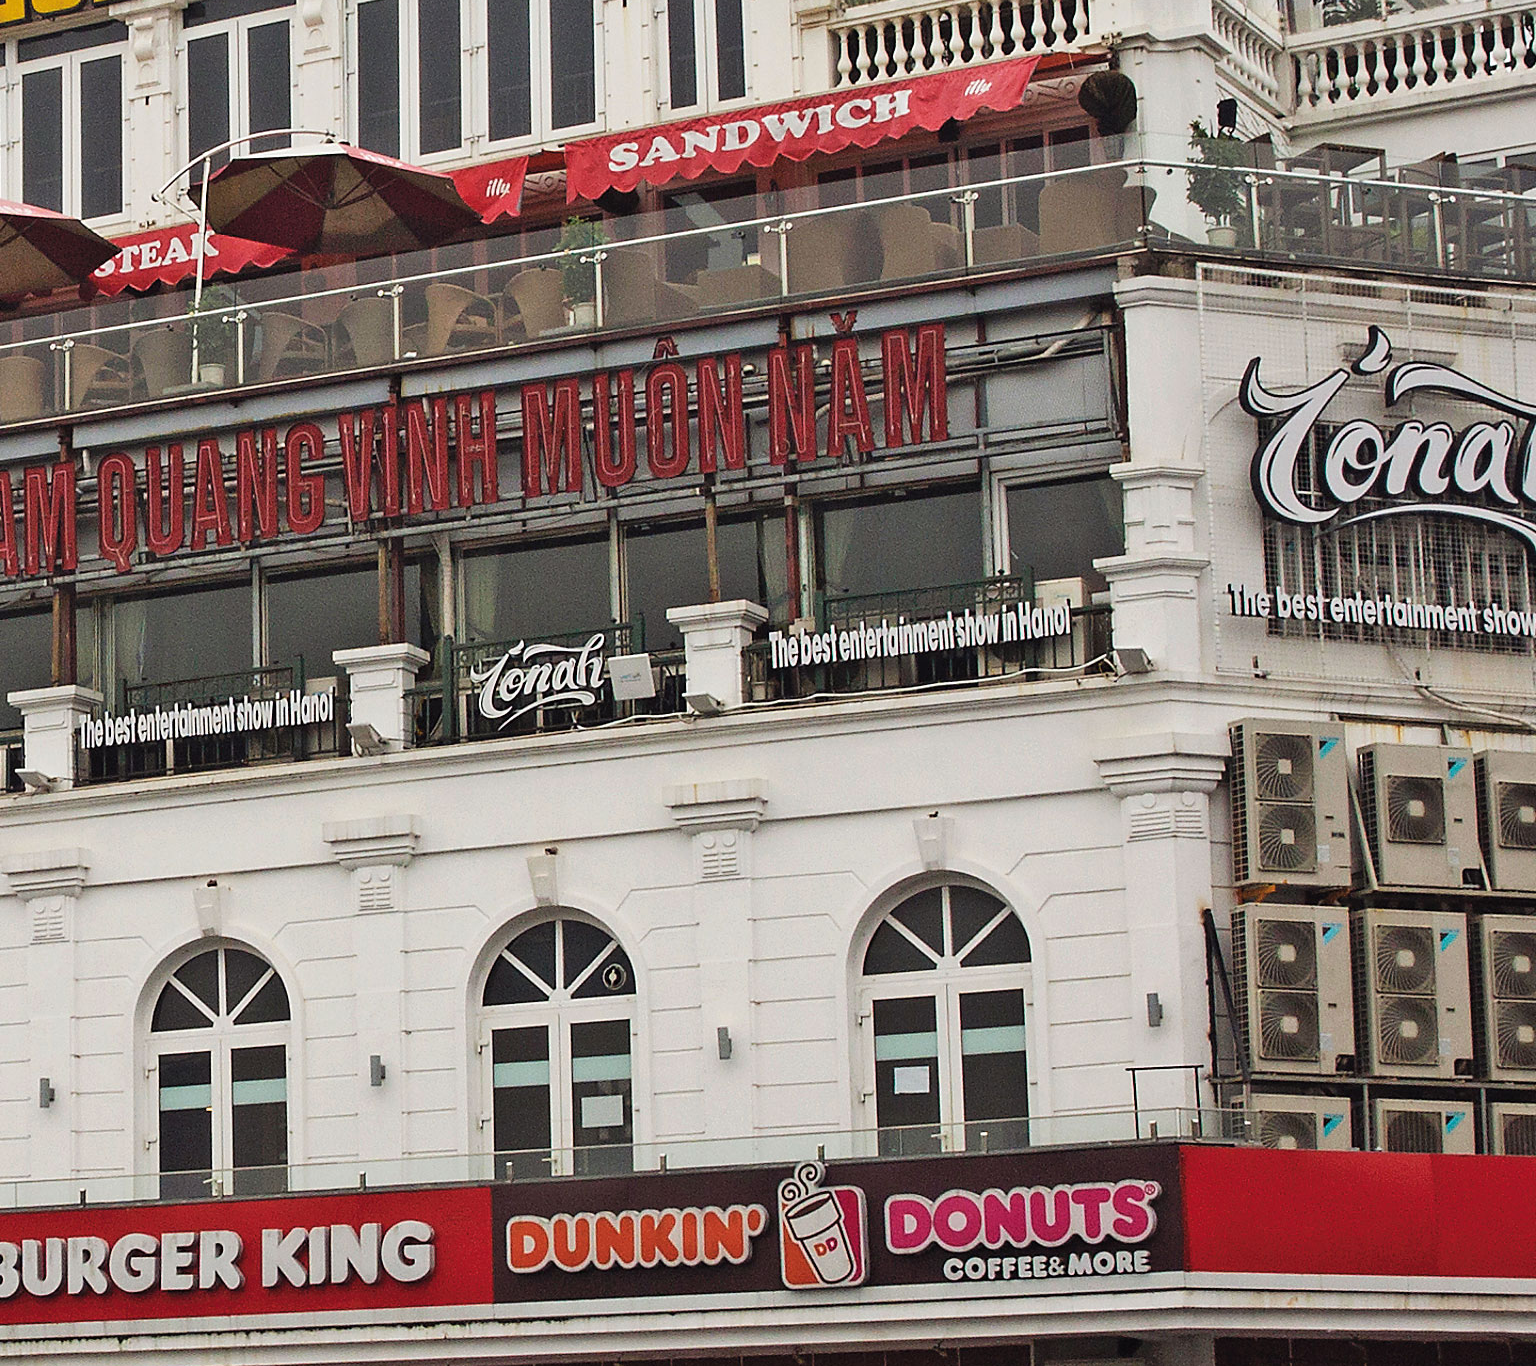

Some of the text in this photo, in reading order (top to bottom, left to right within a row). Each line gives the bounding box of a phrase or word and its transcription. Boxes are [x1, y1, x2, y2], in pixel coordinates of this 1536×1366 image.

[607, 89, 911, 173] SANDWICH
[485, 178, 511, 199] illy
[96, 423, 326, 574] QUANG
[337, 389, 499, 523] VINH
[521, 335, 745, 497] MUÔN
[767, 309, 948, 466] NĂM
[769, 599, 1072, 669] The best entertainment show in Hanoi
[1228, 583, 1271, 617] The
[1275, 585, 1325, 623] best
[1328, 591, 1480, 634] entertainment
[78, 685, 336, 750] The best entertainment show in Hanoi
[261, 1219, 436, 1289] KING
[506, 1203, 770, 1275] DUNKIN'
[813, 1236, 839, 1258] DD
